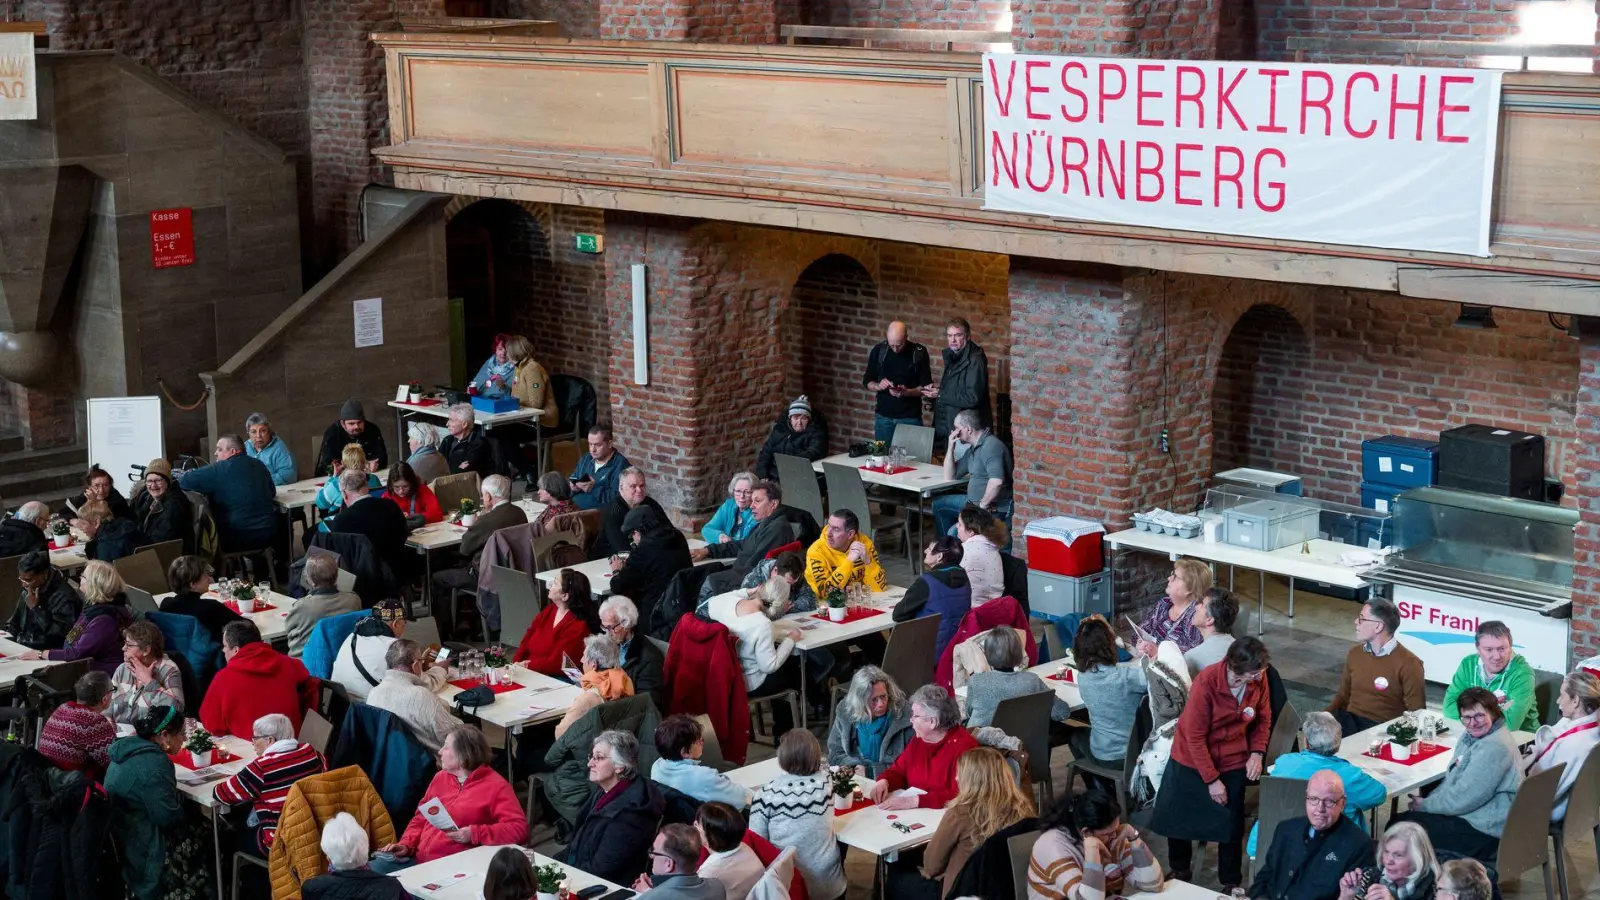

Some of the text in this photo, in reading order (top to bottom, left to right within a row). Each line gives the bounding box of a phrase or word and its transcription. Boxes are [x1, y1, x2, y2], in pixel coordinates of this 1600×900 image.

[988, 58, 1474, 143] VESPERKIRCHE
[991, 129, 1286, 213] NÜRNBERG
[152, 212, 179, 221] Kasse
[153, 232, 181, 242] Essen
